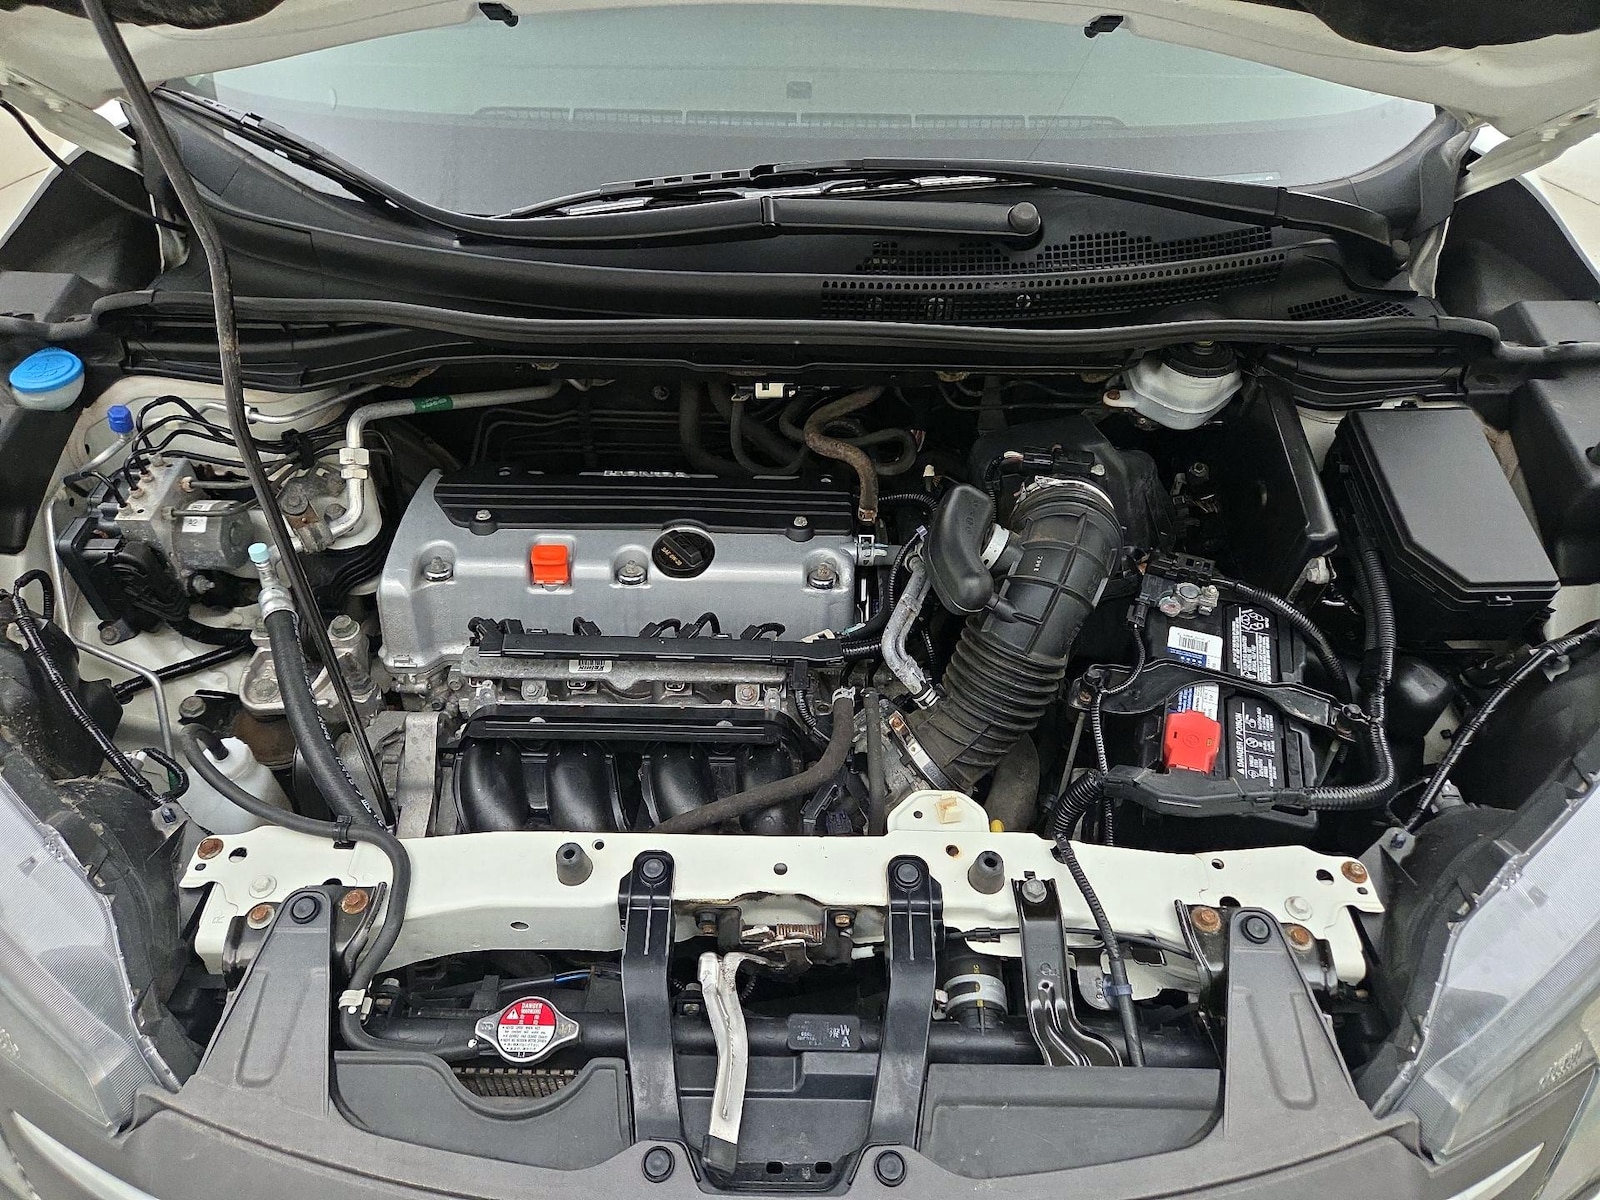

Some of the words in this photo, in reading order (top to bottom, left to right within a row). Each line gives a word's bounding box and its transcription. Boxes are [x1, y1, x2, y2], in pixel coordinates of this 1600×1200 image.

[1235, 712, 1243, 735] POISON
[1236, 741, 1245, 768] DANGER
[840, 1024, 850, 1036] W
[841, 1036, 851, 1047] A
